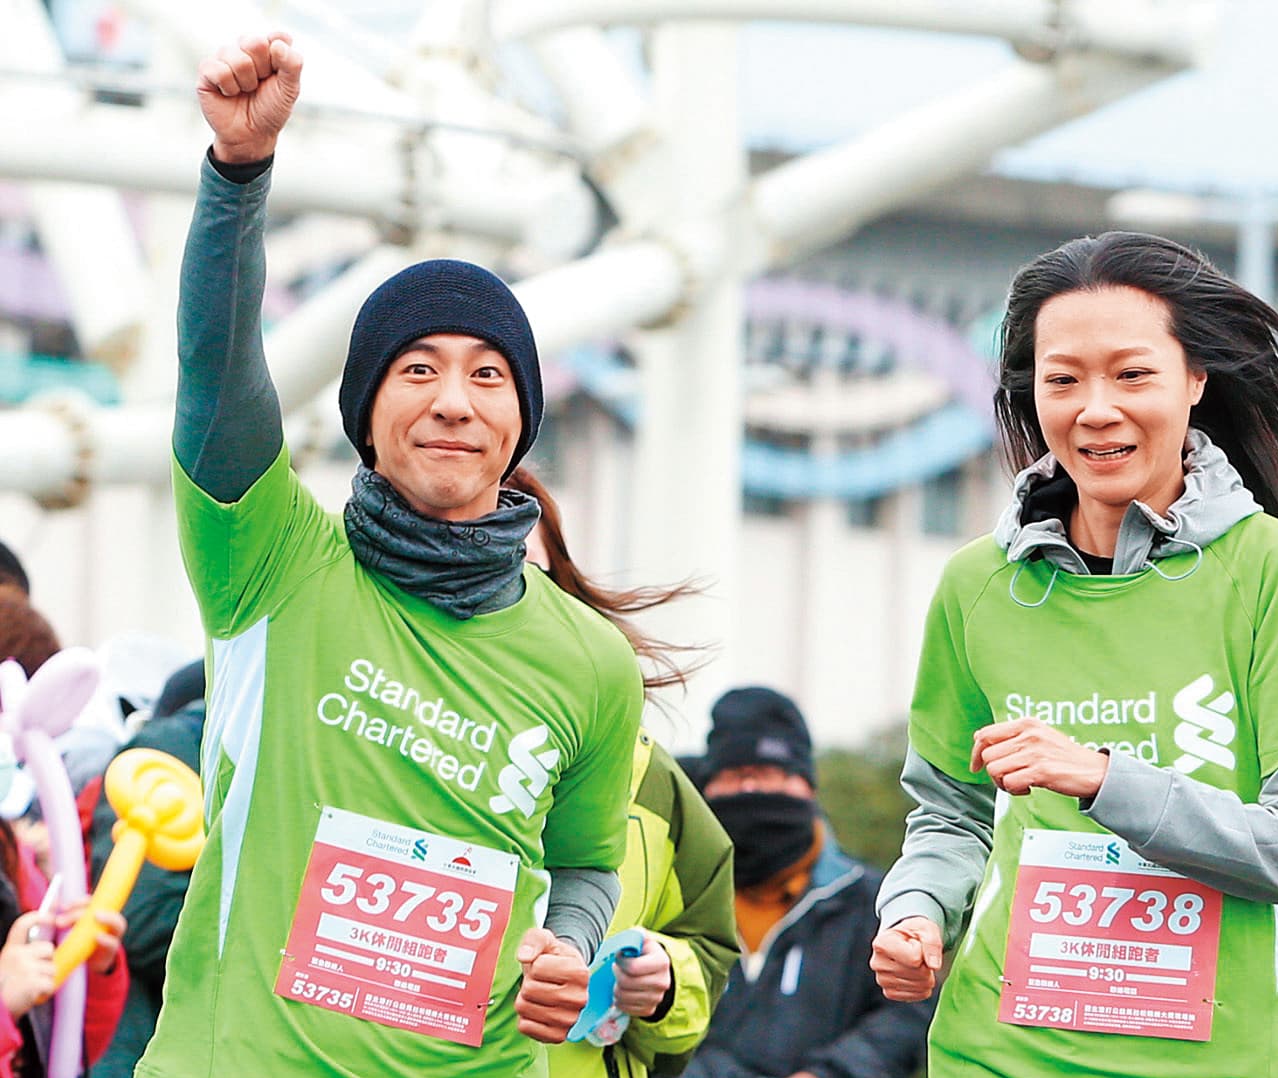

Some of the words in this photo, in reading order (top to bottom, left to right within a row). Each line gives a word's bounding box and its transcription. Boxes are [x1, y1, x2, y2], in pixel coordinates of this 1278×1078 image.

[344, 658, 498, 753] Standard
[1005, 691, 1156, 725] Standard
[317, 692, 487, 792] Chartered
[366, 837, 410, 857] Chartered
[371, 829, 412, 847] Standard
[1064, 850, 1104, 862] Chartered
[320, 862, 499, 941] 53735
[1028, 881, 1206, 936] 53738
[375, 957, 412, 978] 9:30
[1089, 966, 1125, 982] 9:30
[290, 979, 354, 1009] 53735
[1013, 1003, 1073, 1024] 53738
